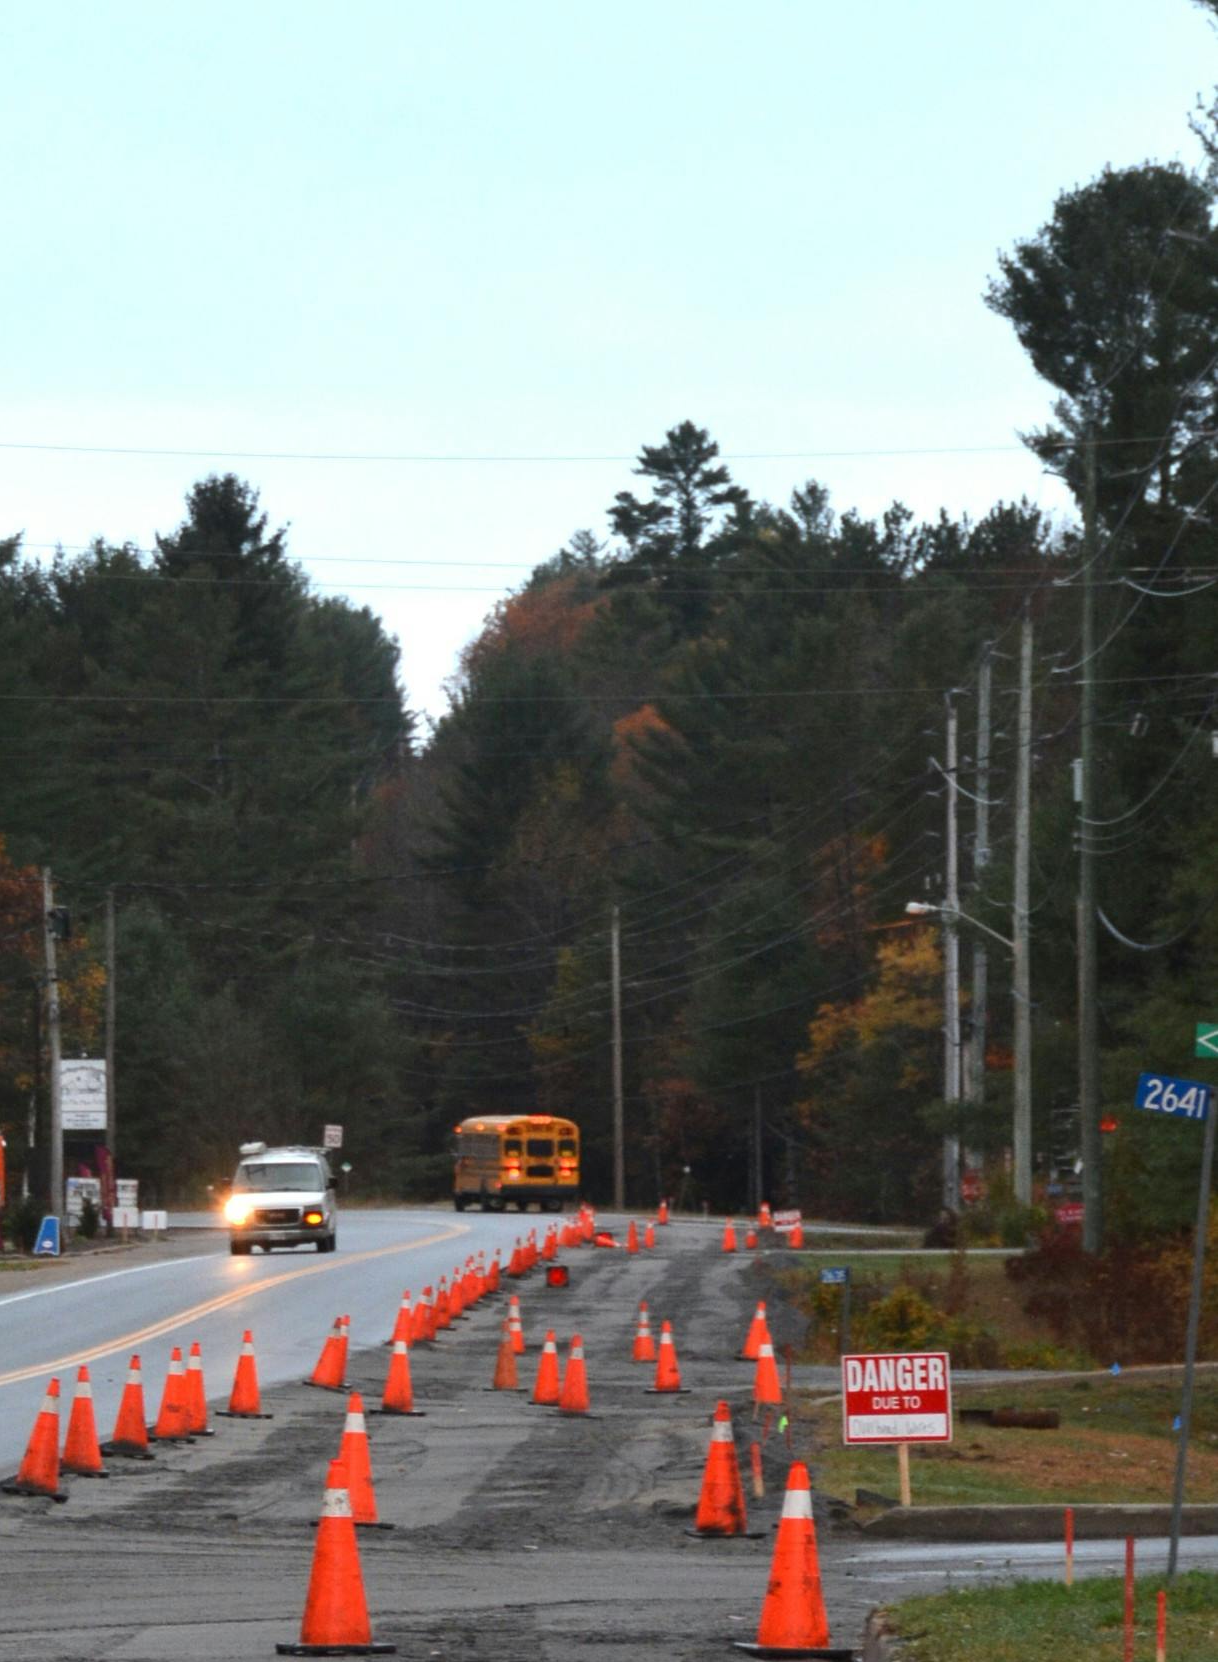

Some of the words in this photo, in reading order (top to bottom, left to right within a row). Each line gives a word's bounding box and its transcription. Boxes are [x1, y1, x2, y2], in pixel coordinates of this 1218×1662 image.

[1143, 1078, 1207, 1118] 2641
[846, 1358, 945, 1392] DANGER
[872, 1396, 900, 1410] DUE
[902, 1395, 921, 1409] TO
